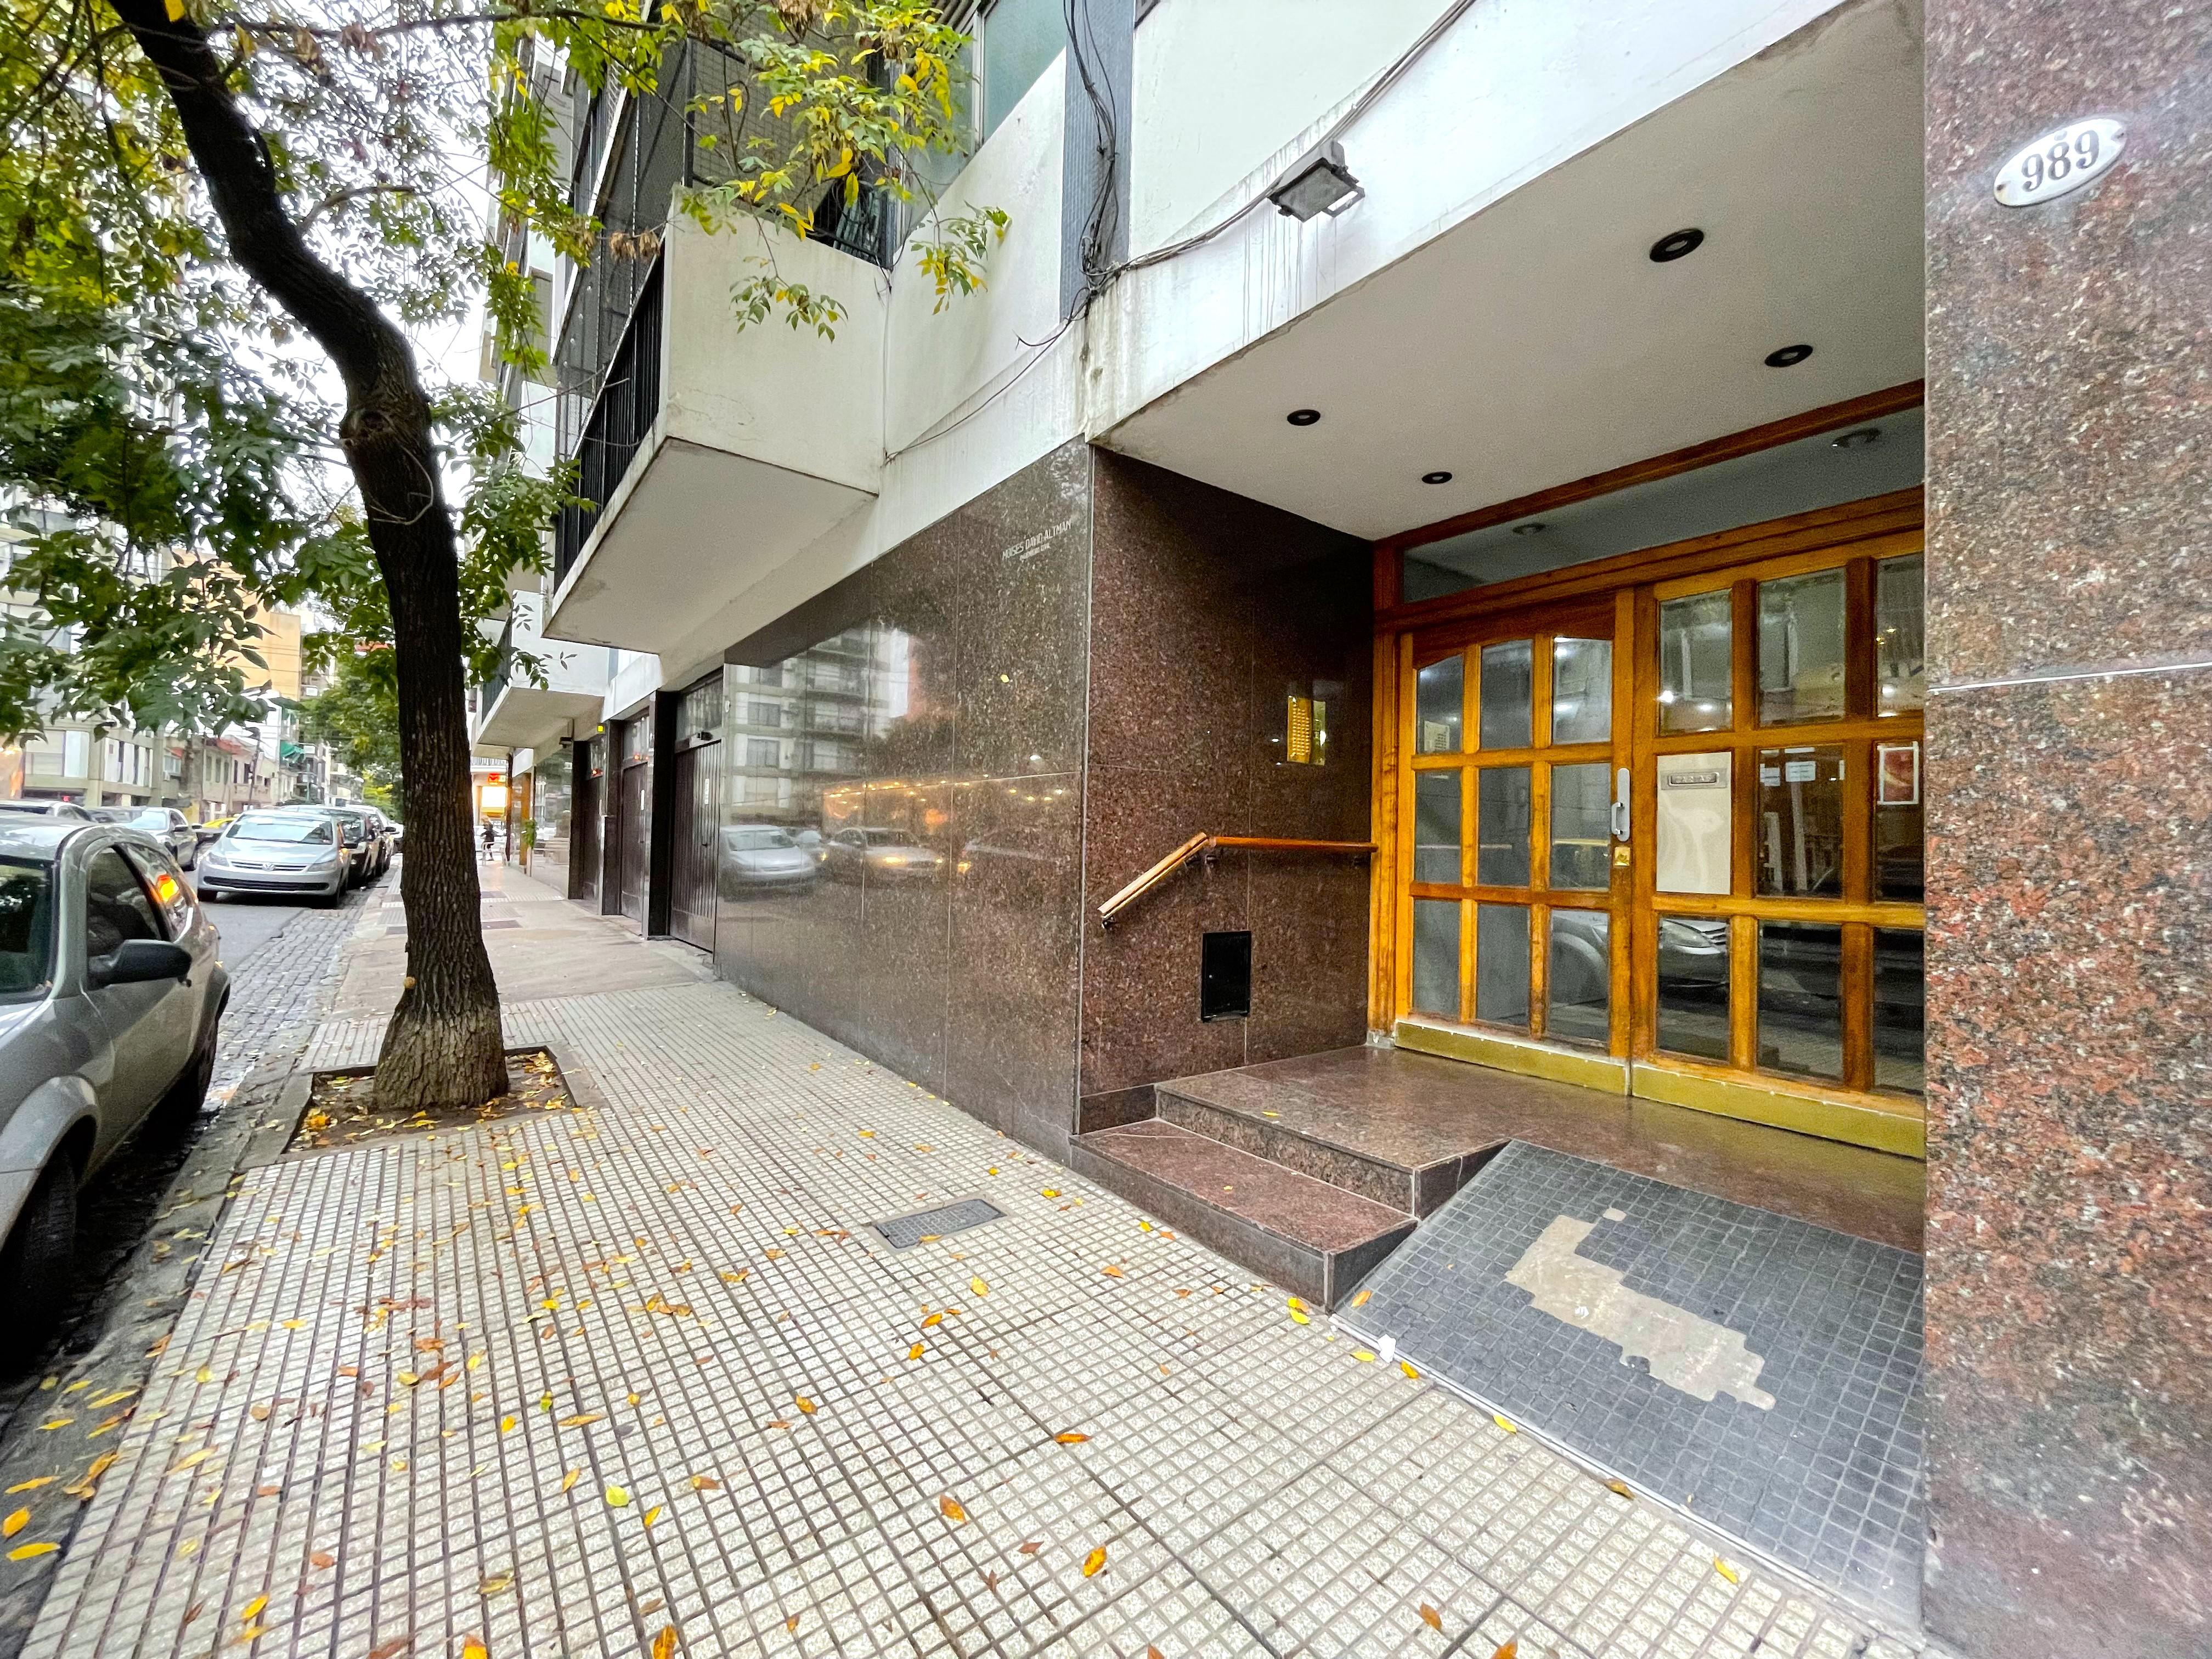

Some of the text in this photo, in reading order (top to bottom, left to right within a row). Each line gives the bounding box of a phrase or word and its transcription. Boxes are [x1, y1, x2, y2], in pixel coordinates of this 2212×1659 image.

[2021, 129, 2100, 192] 989
[1025, 532, 1043, 550] DAVID
[1044, 518, 1071, 541] ALTMAN
